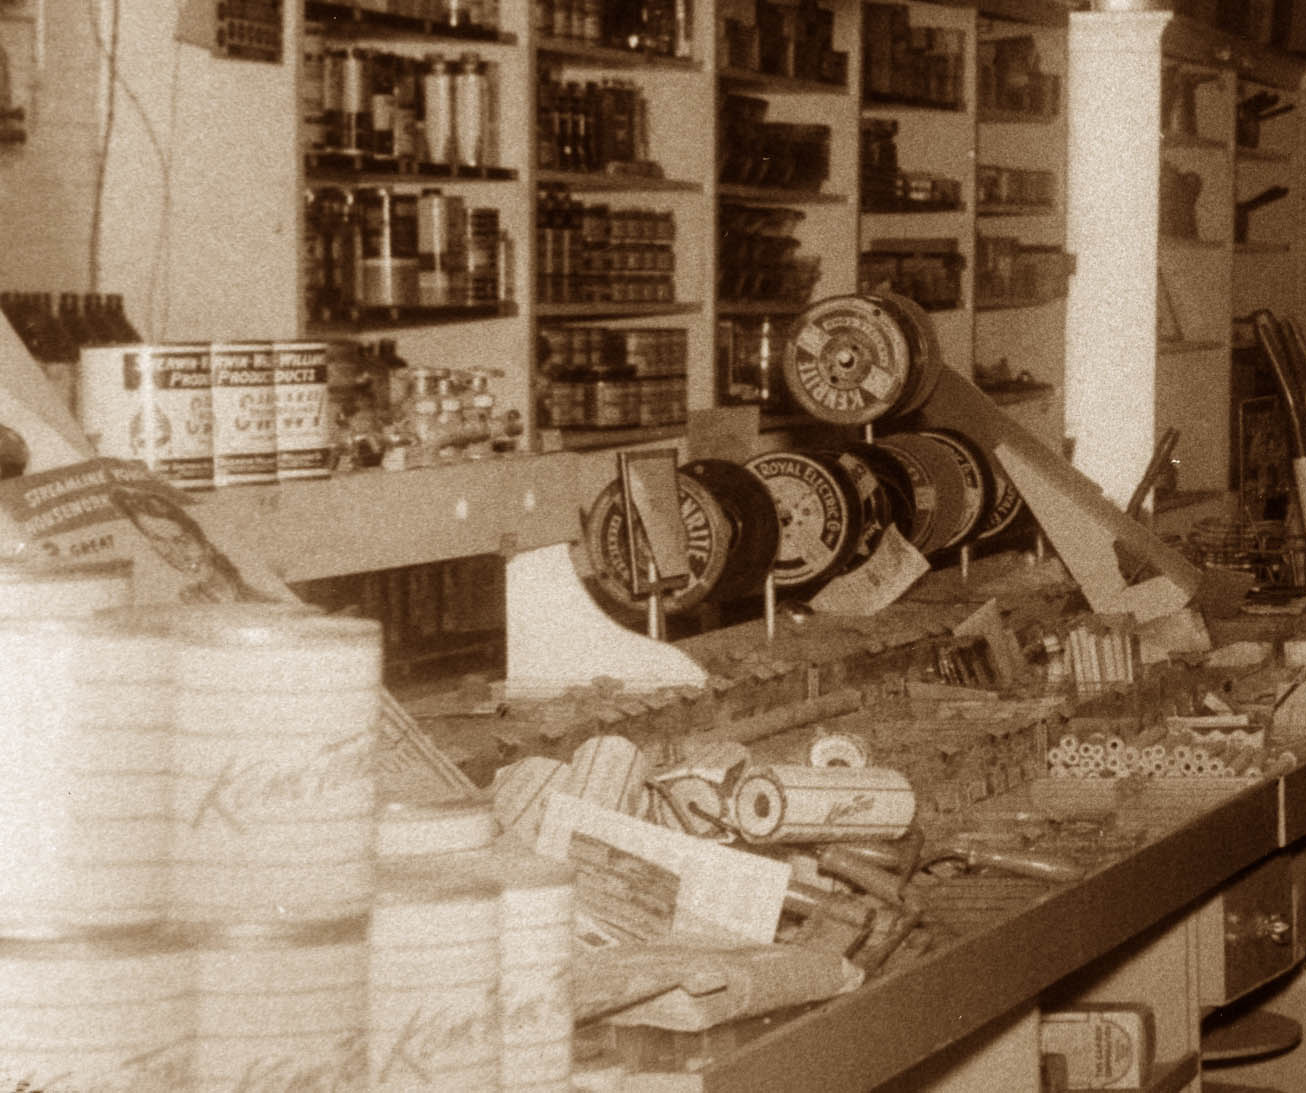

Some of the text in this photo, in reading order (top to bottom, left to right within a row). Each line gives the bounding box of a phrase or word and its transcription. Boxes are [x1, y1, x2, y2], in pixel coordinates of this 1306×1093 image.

[760, 461, 801, 476] ROYAL
[803, 466, 840, 519] ELECTRIC
[70, 534, 114, 557] GREAT
